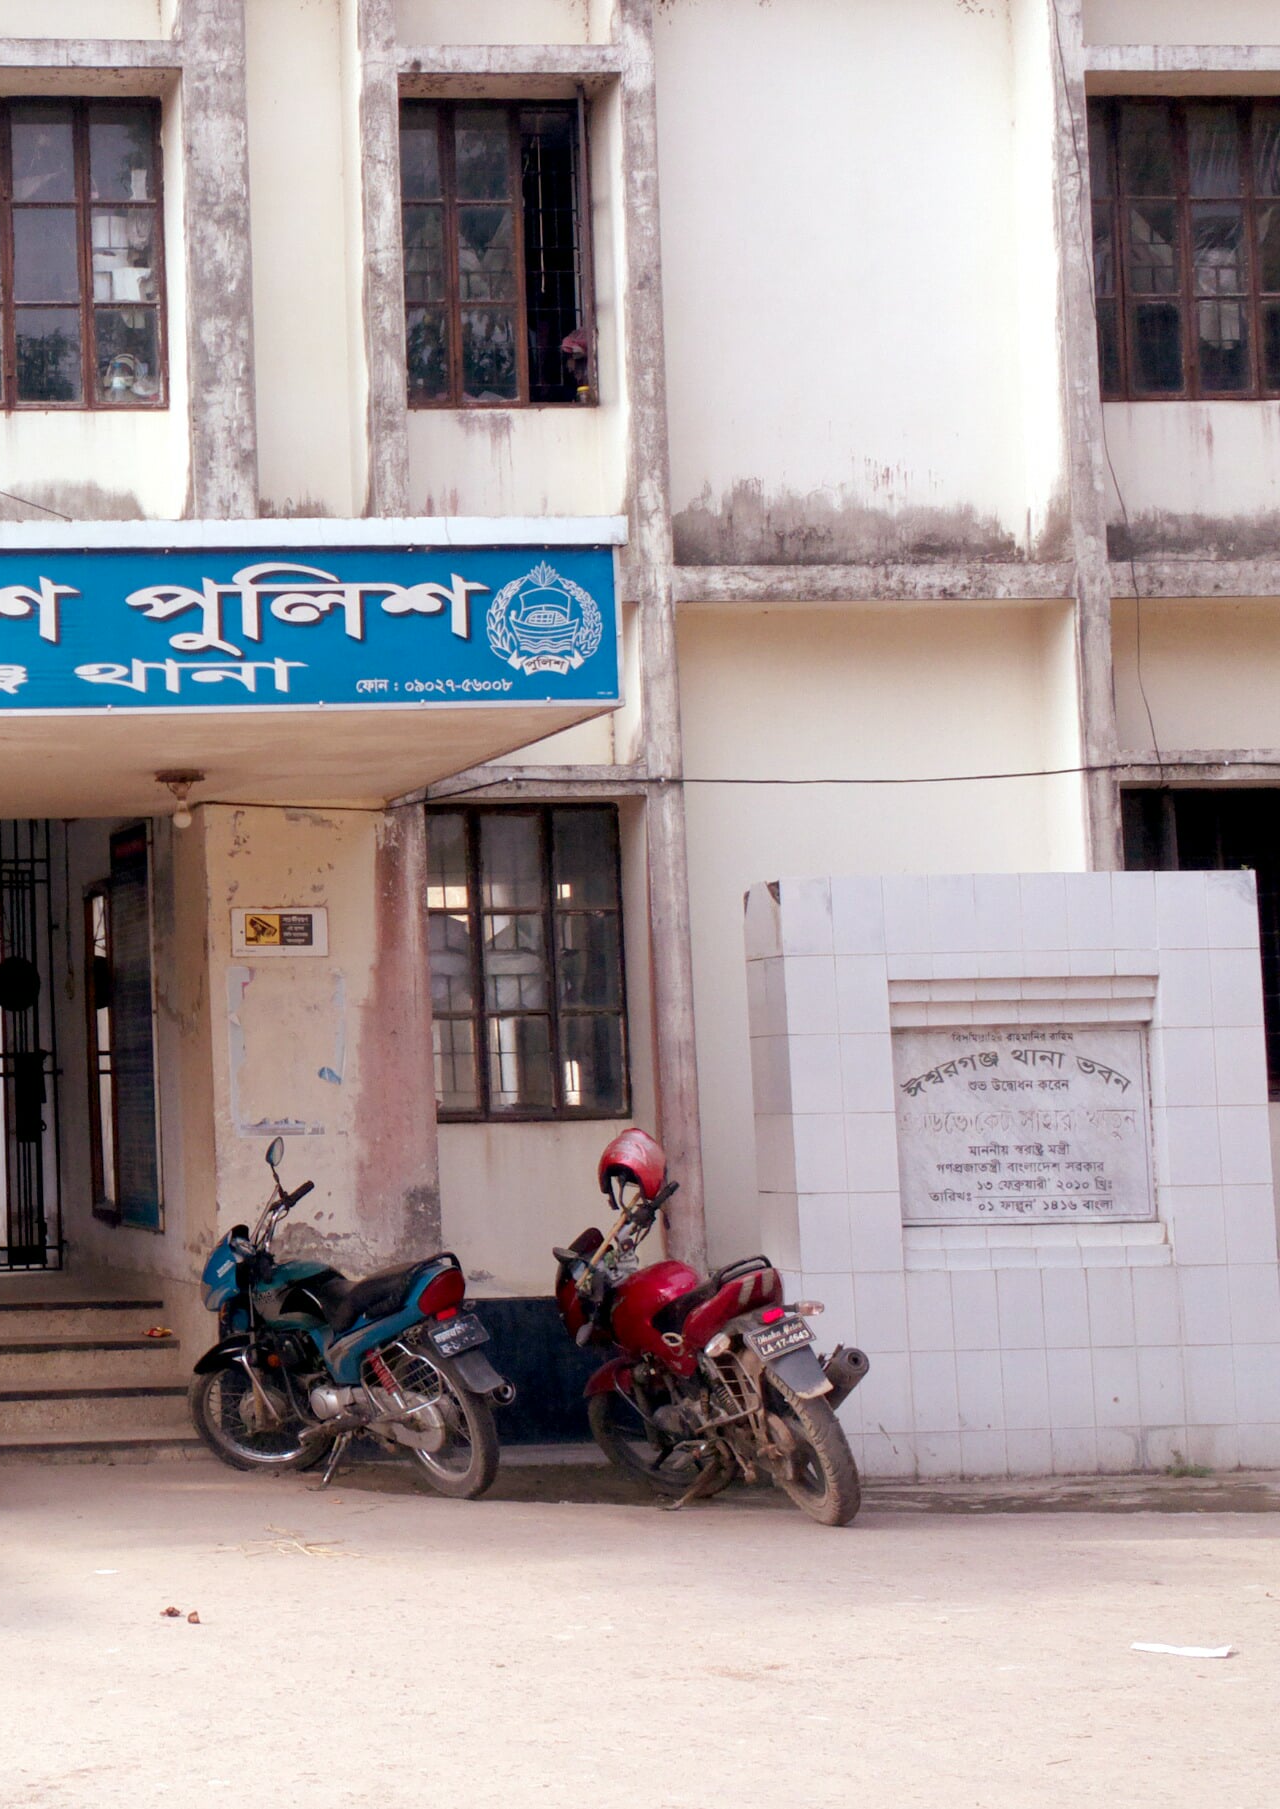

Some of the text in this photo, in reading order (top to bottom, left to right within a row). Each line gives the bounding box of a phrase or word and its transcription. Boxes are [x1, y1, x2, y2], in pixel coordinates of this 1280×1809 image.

[127, 562, 490, 657] পুলিশ
[524, 655, 566, 671] পুলিশ
[74, 657, 308, 694] থানা
[356, 678, 389, 694] ফোন
[404, 678, 513, 694] ০৯০২৭-৫৬০০৮
[899, 1048, 1132, 1097] ঈশ্বরগঞ্জ থানা ভবন
[1038, 1079, 1069, 1092] করেন
[1007, 1161, 1060, 1174] বাংলাদেশ
[1065, 1161, 1104, 1173] সরকার
[1056, 1179, 1089, 1191] ২০১০
[978, 1200, 994, 1212] ০১
[1043, 1200, 1077, 1212] ১৪১৬
[1082, 1199, 1112, 1211] বাংলা
